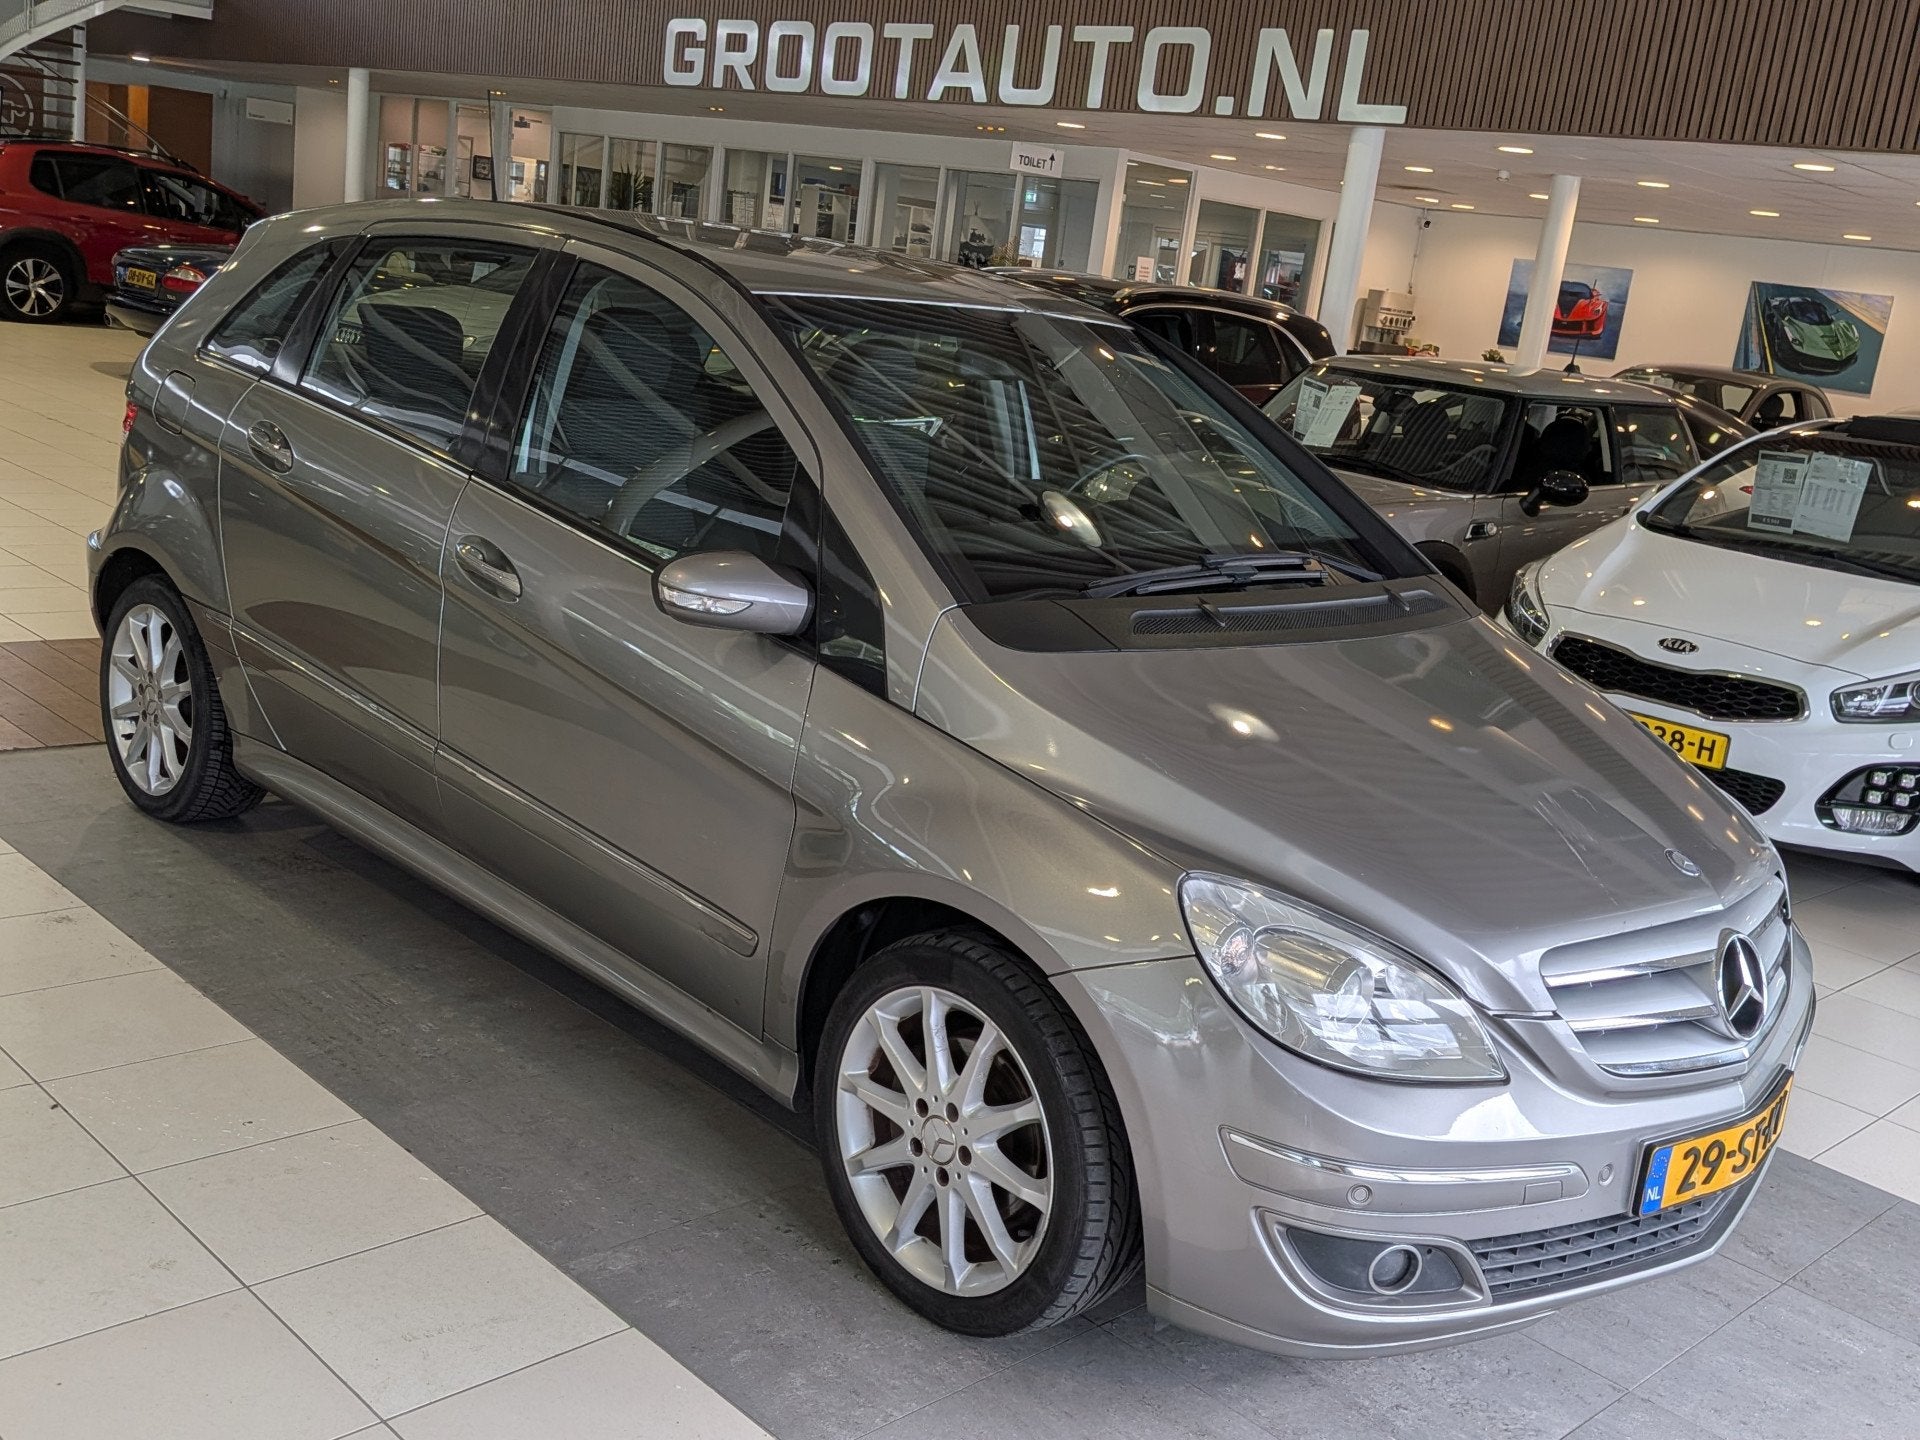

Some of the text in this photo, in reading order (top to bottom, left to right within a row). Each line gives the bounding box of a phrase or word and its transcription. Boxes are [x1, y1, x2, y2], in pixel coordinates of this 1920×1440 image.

[663, 18, 1407, 125] GROOTAUTO.NL
[1019, 154, 1047, 169] TOILET
[1663, 639, 1691, 652] KIA
[1640, 721, 1717, 763] 38-H
[1645, 1186, 1661, 1202] NL
